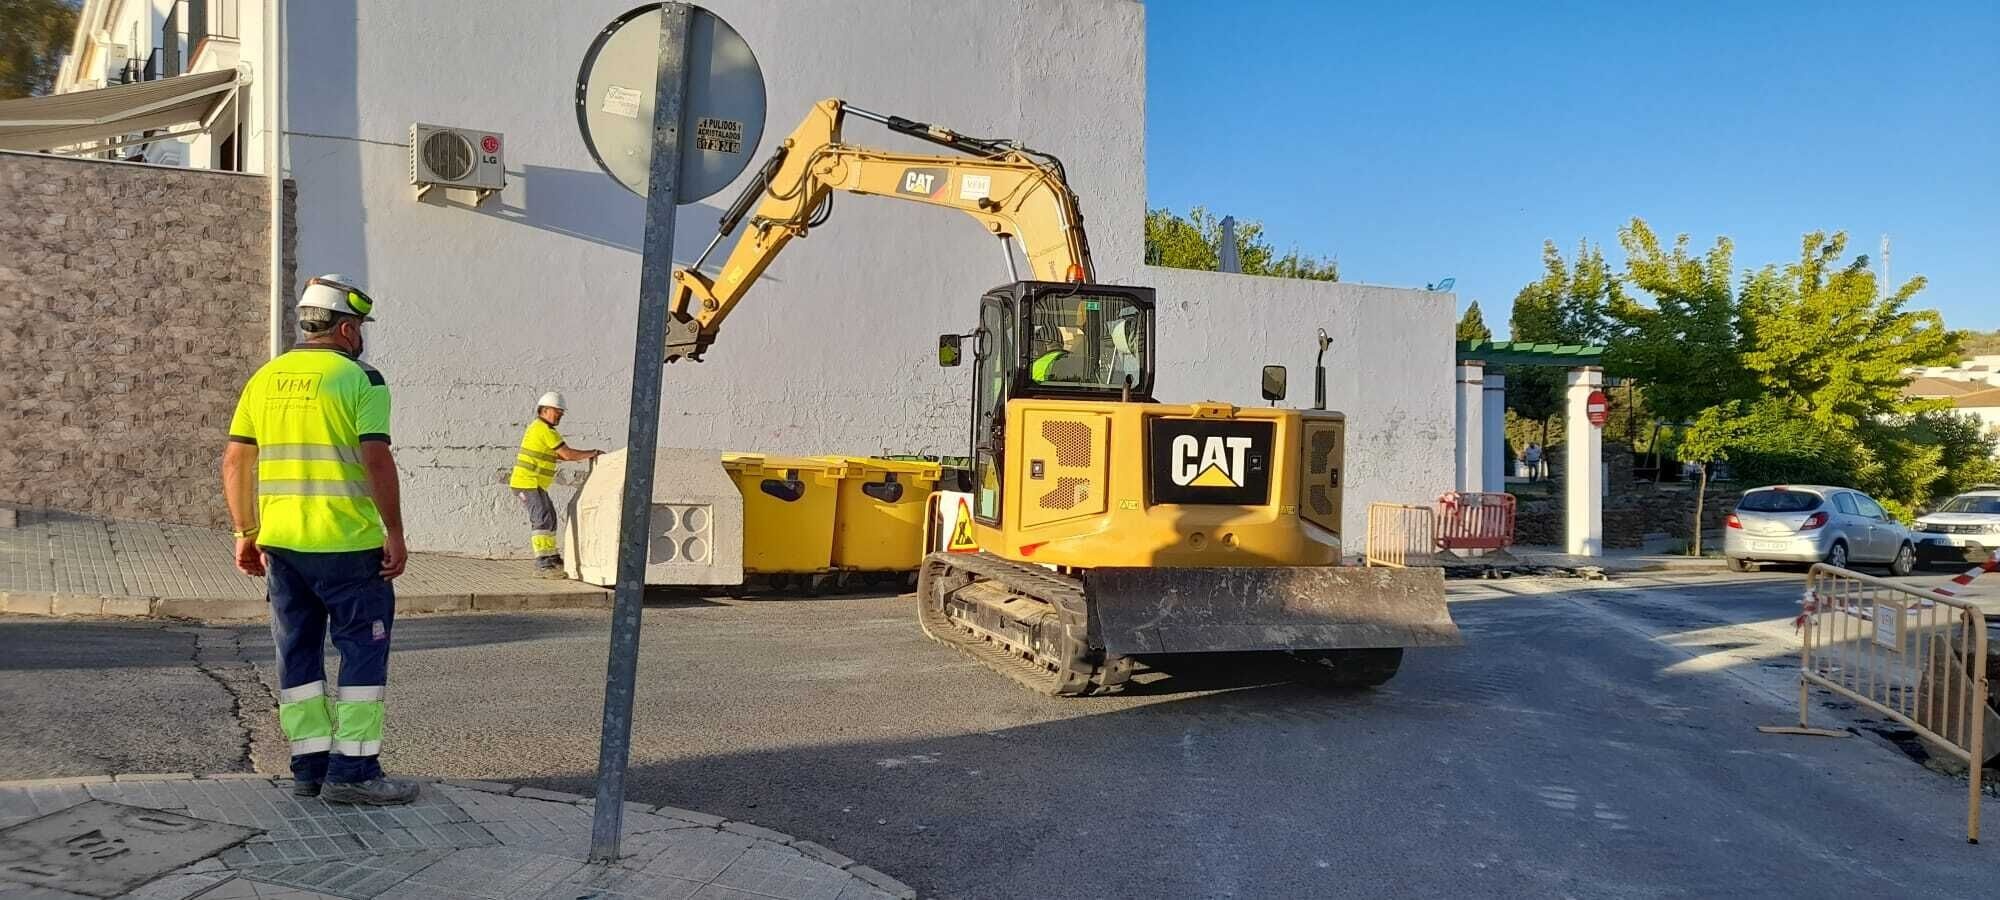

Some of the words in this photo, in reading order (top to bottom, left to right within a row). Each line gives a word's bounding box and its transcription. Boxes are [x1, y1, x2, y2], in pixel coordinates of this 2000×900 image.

[708, 118, 737, 131] PULIDOS
[483, 155, 497, 165] LG
[905, 171, 935, 194] CAT
[276, 378, 312, 392] VFM
[1171, 434, 1252, 488] CAT
